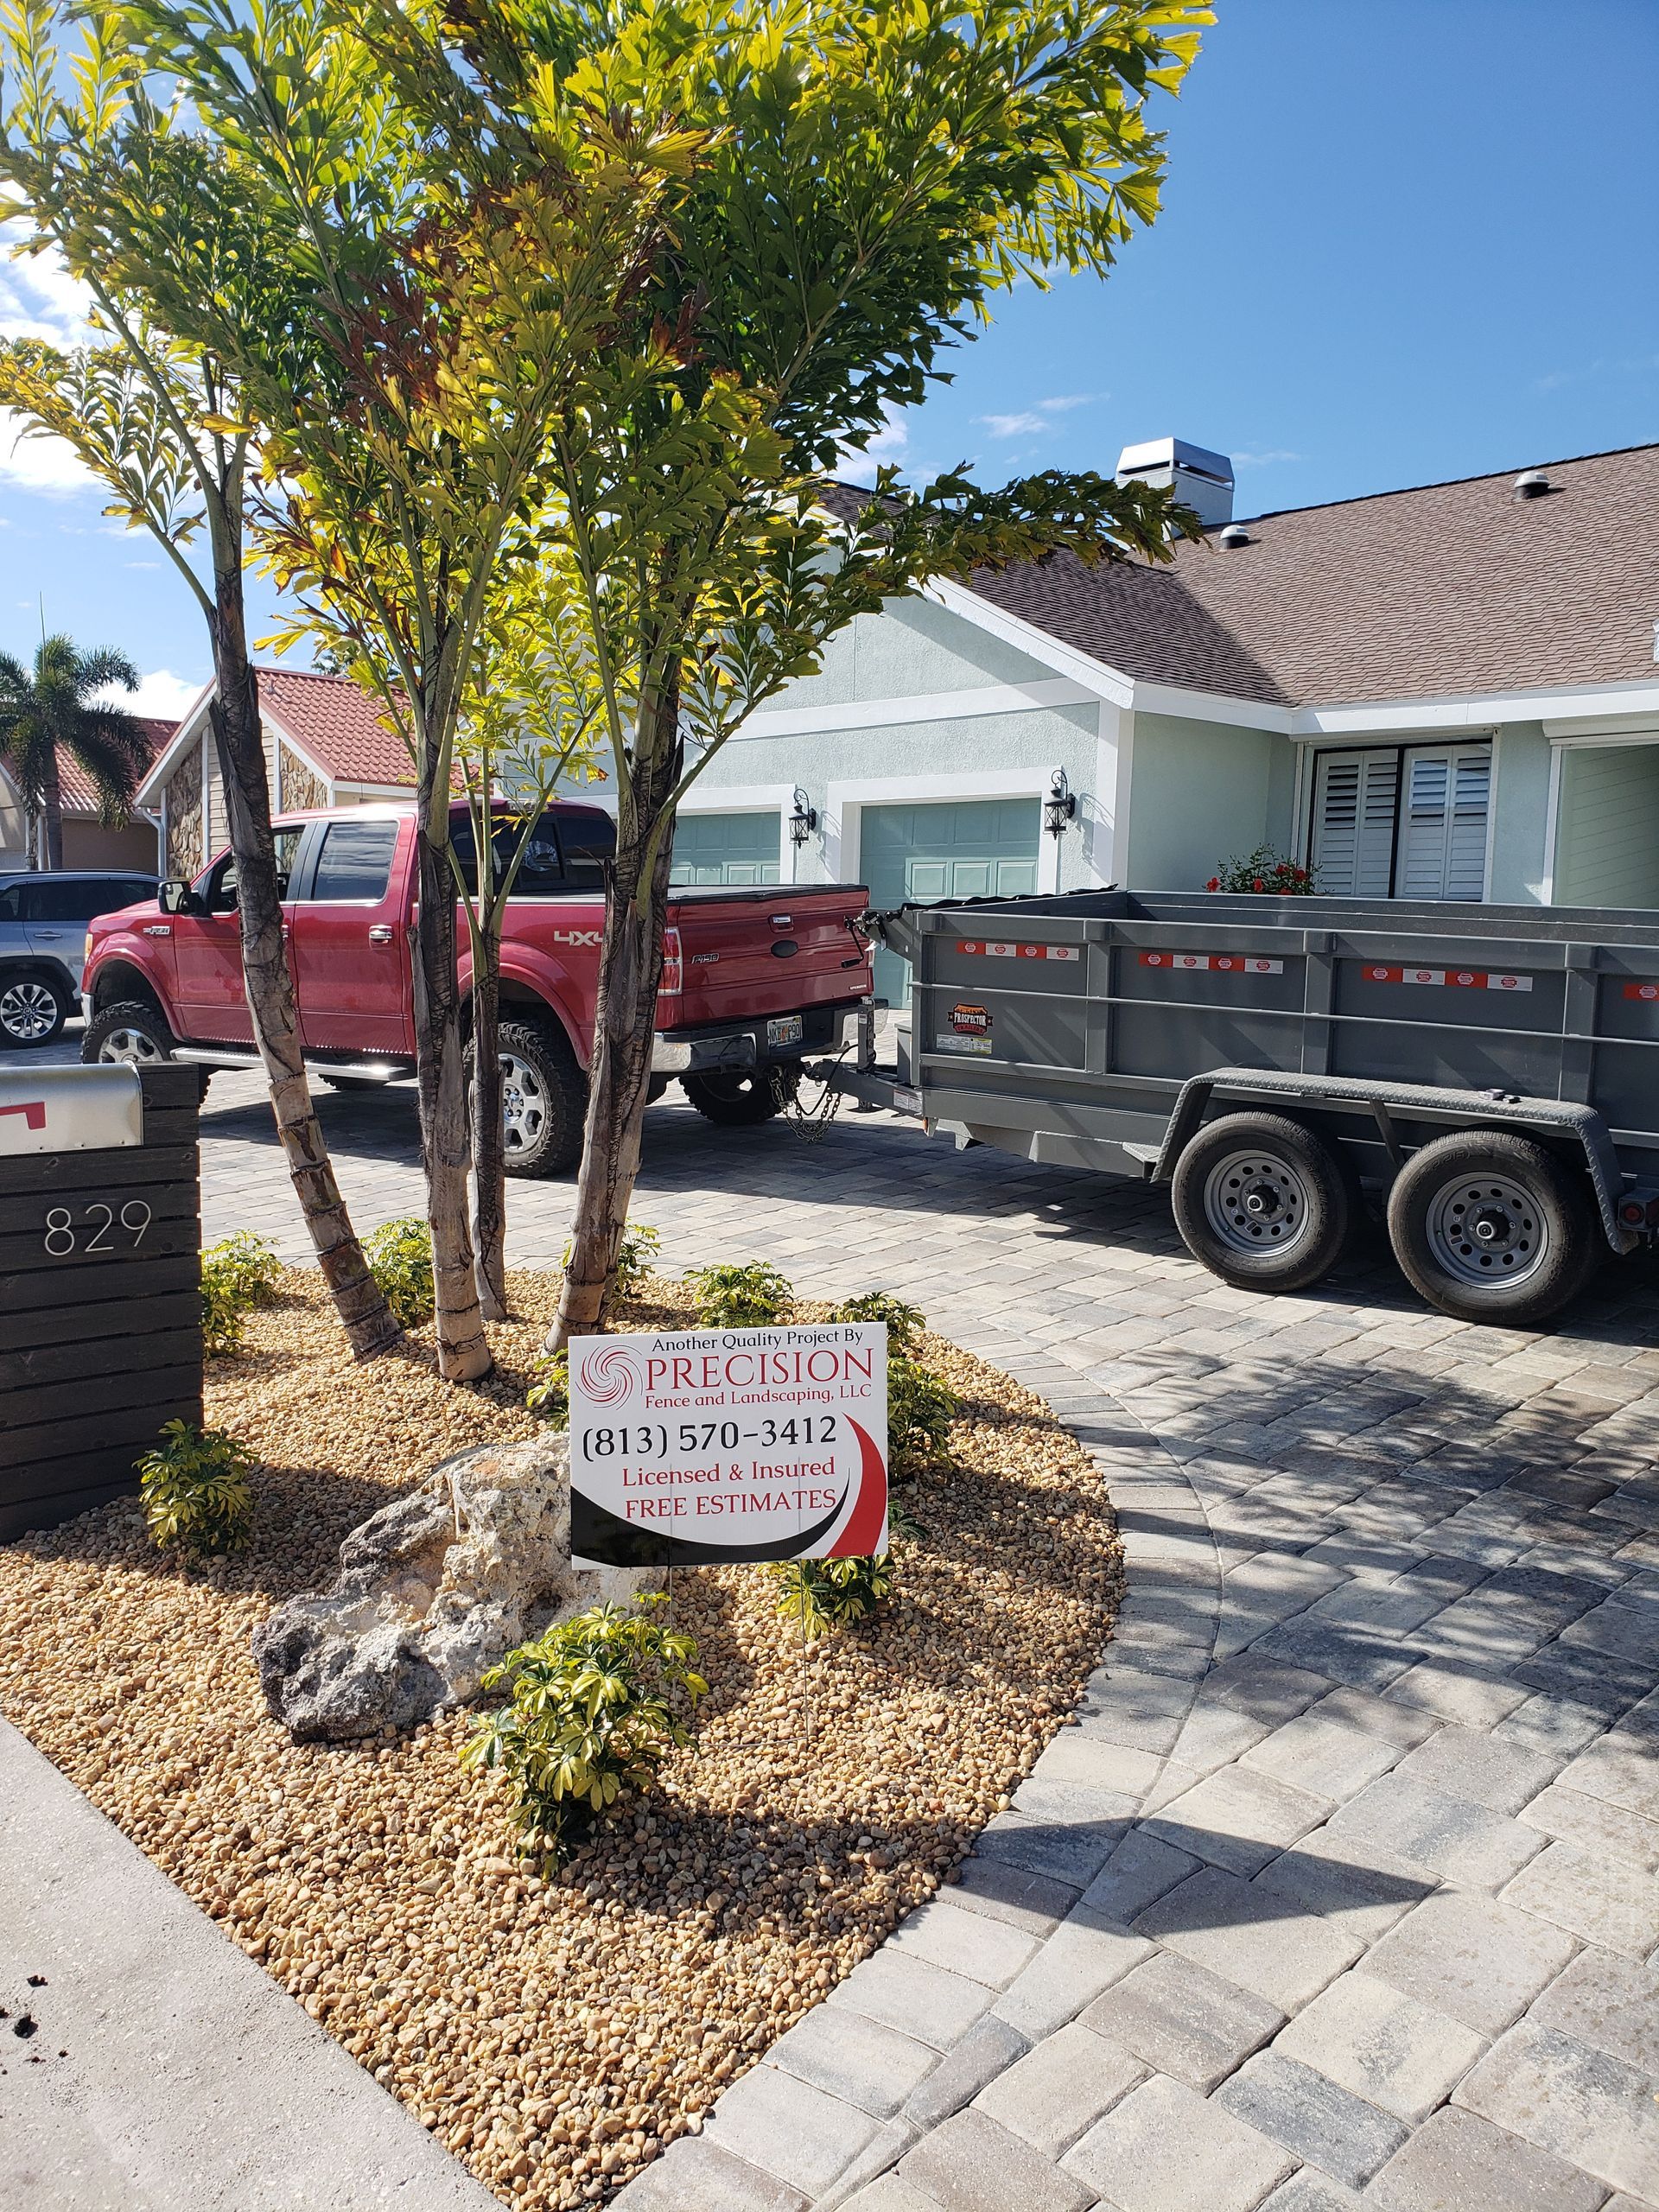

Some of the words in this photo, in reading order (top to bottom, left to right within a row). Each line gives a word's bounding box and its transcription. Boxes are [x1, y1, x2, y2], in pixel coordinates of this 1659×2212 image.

[954, 1012, 986, 1027] PROSPECTOR
[44, 1199, 152, 1257] 829
[652, 1335, 718, 1352] Another
[722, 1332, 782, 1351] Quality
[787, 1330, 839, 1347] Project
[844, 1329, 863, 1344] By
[645, 1347, 874, 1391] PRECISION
[645, 1394, 690, 1408] Fence
[695, 1391, 725, 1407] and
[731, 1386, 835, 1406] Landscaping,
[839, 1383, 872, 1398] LLC
[582, 1424, 668, 1462] (813)
[679, 1415, 836, 1452] 570-3412
[622, 1464, 720, 1487] Licensed
[728, 1465, 743, 1481] &
[752, 1456, 836, 1480] Insured
[626, 1497, 688, 1519] FREE
[696, 1489, 837, 1516] ESTIMATES
